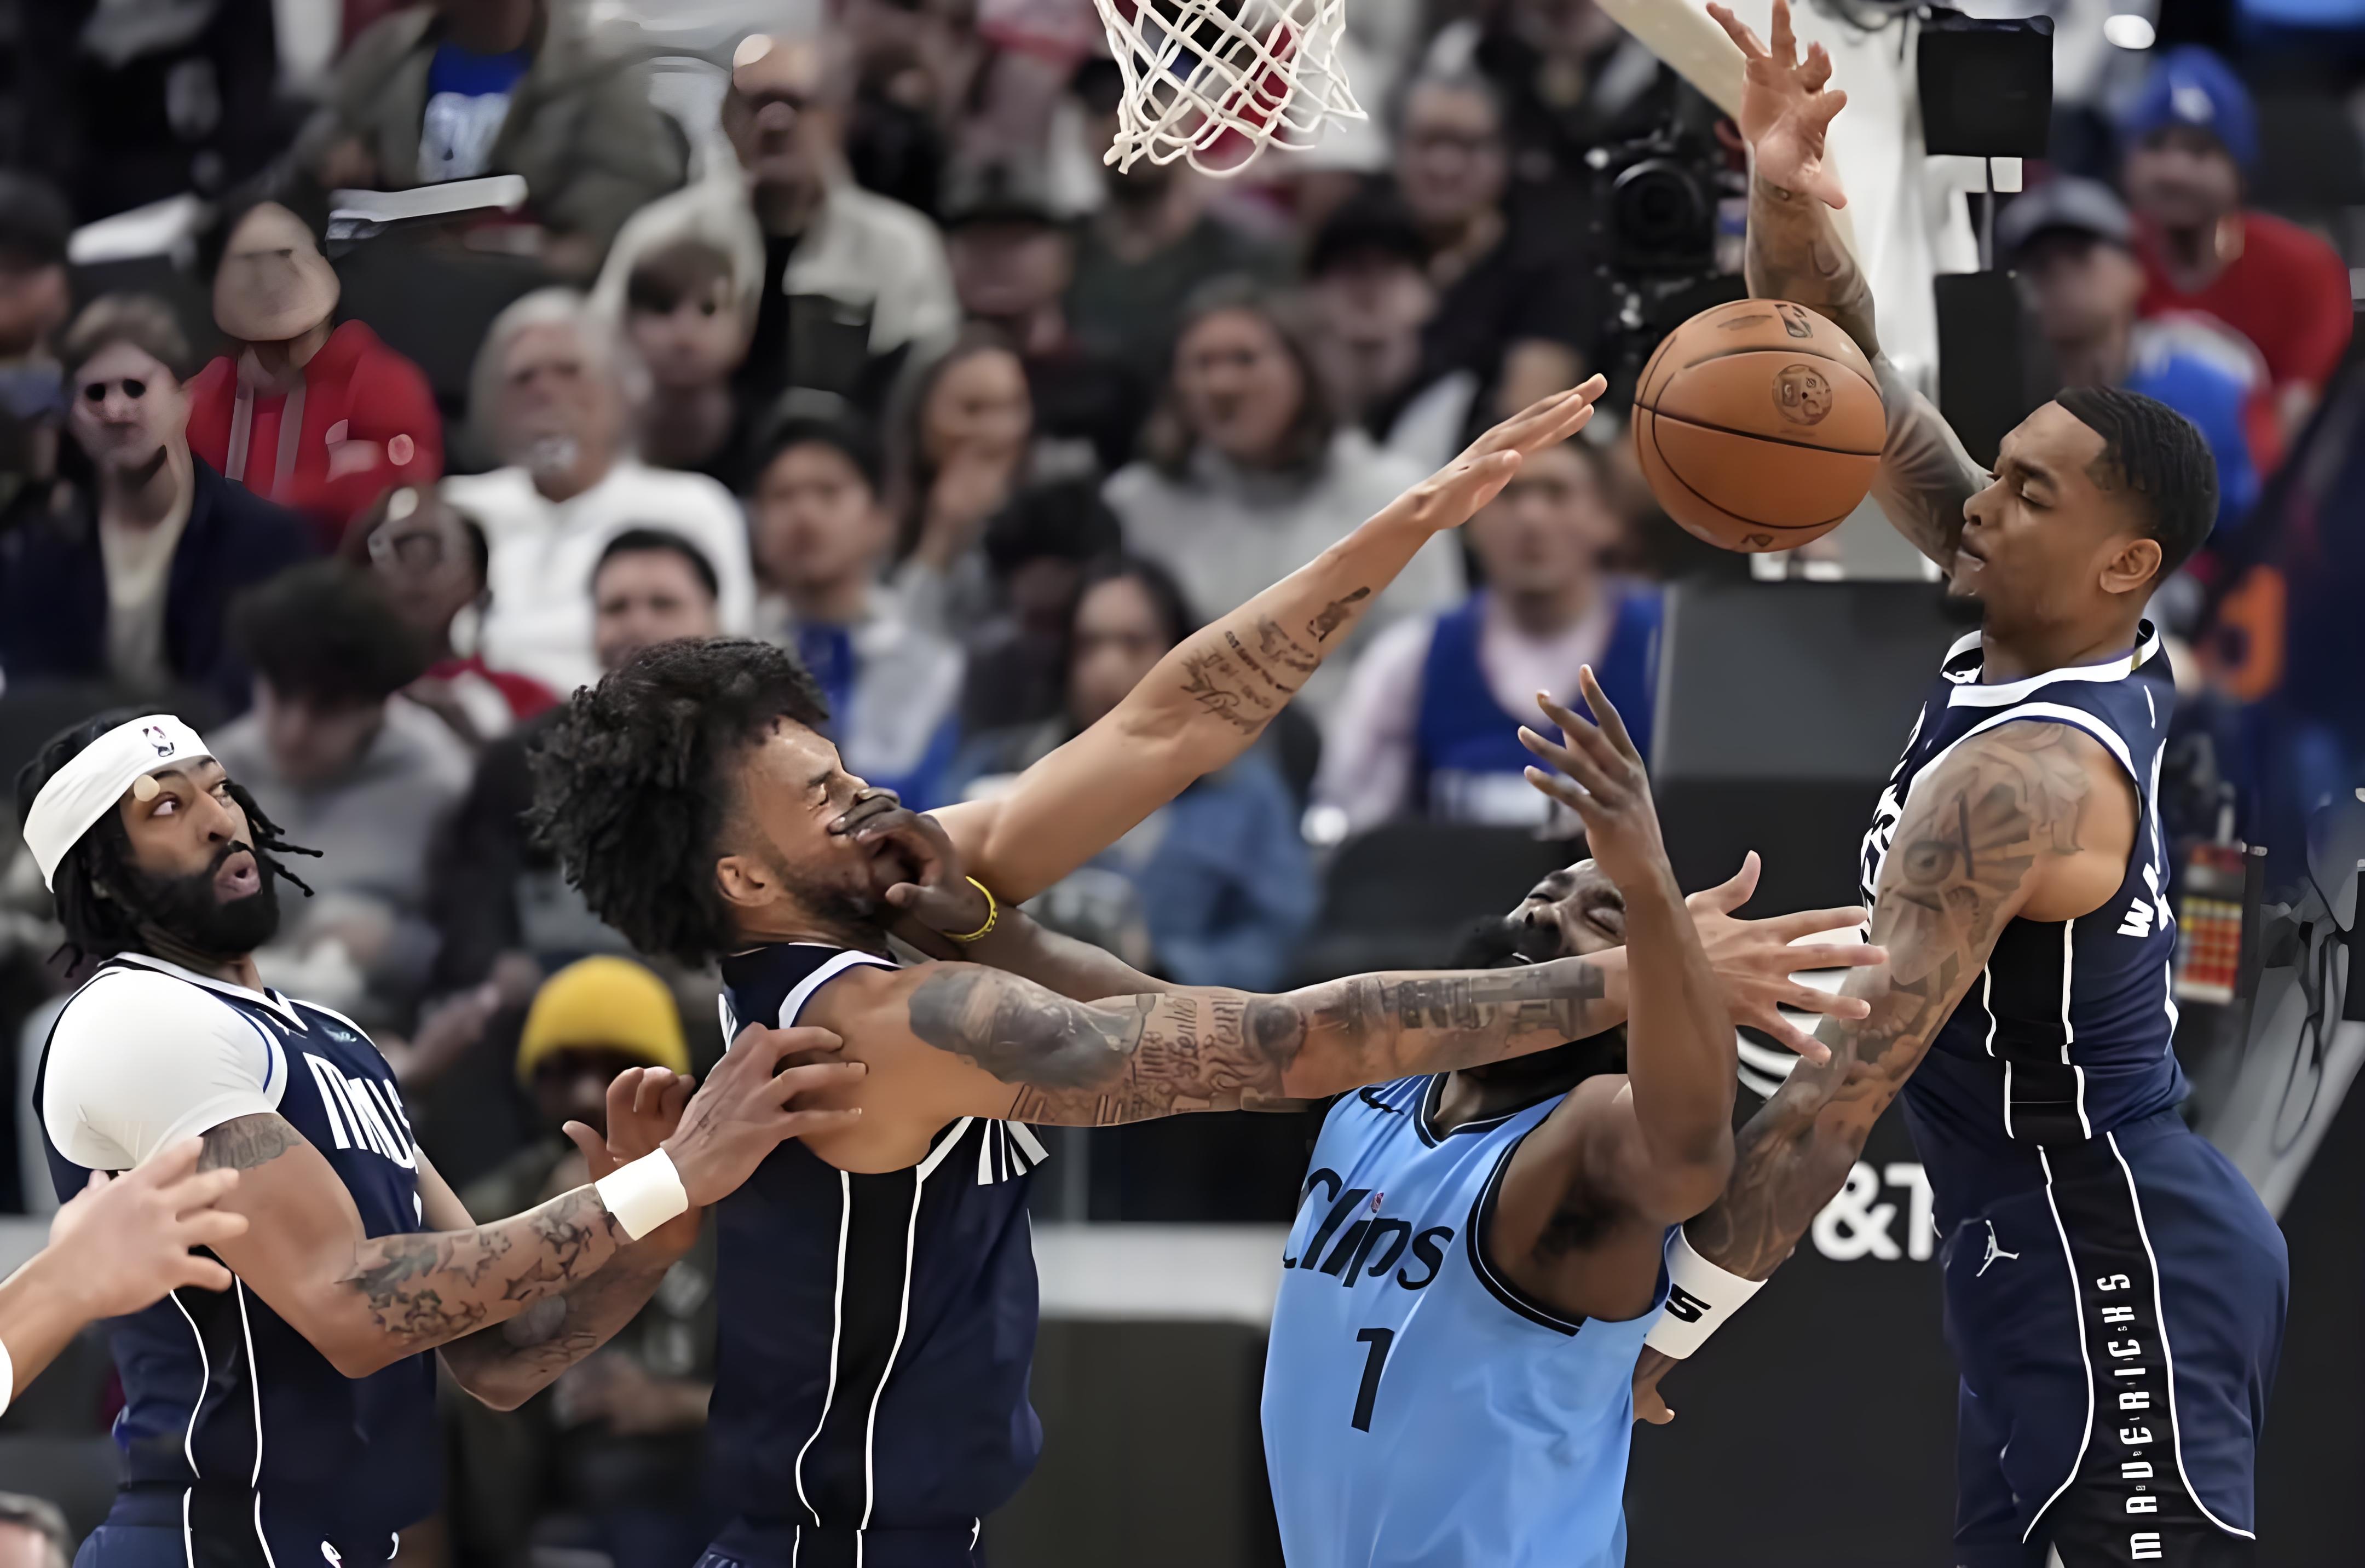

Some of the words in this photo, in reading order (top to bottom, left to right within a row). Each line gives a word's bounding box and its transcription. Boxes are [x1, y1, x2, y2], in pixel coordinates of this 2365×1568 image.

[1283, 1167, 1455, 1290] Clips
[1351, 1327, 1395, 1433] 1
[2096, 1273, 2162, 1560] MAVERICKS
